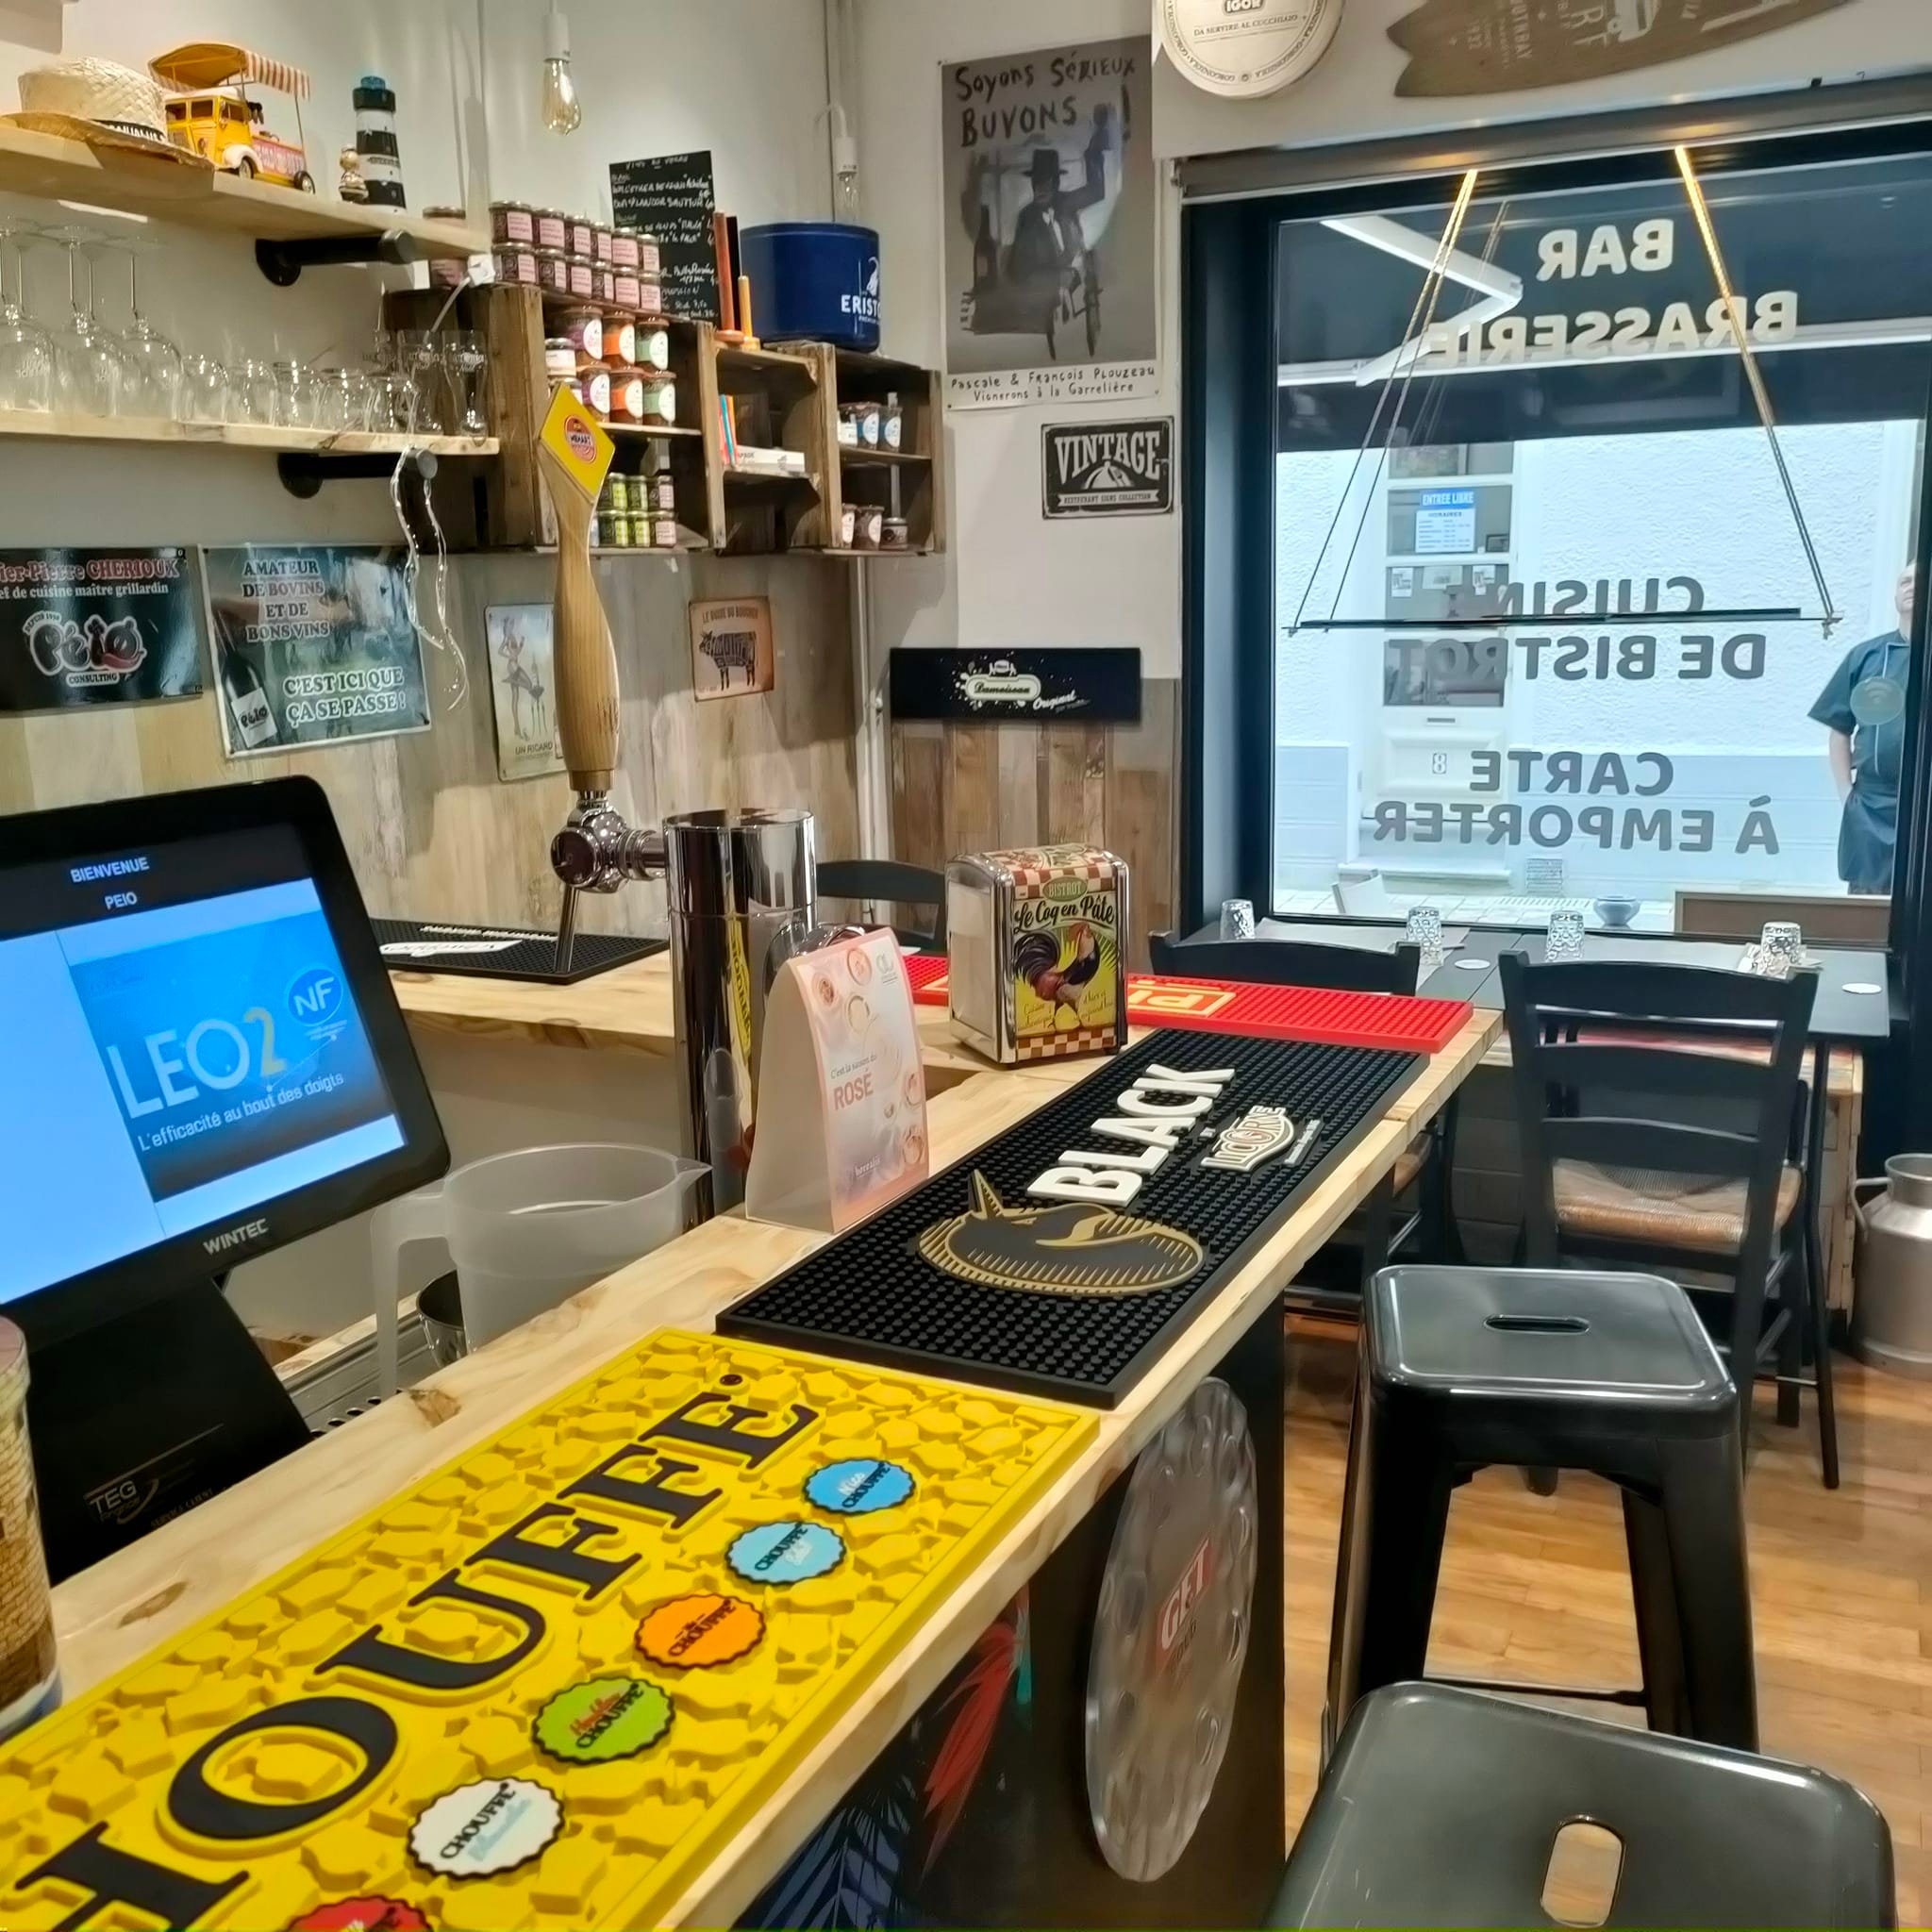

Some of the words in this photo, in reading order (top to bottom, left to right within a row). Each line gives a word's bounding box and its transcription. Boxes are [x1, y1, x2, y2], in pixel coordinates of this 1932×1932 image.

[955, 63, 1036, 103] Soyons
[960, 95, 1078, 148] BUVONS
[974, 390, 1029, 403] Vignerons
[1050, 384, 1060, 397] la
[1010, 373, 1020, 386] &
[1054, 430, 1161, 486] VINTAGE
[86, 558, 180, 580] CHERIOUX
[243, 559, 319, 576] AMATEUR
[12, 588, 27, 599] de
[29, 584, 73, 598] cuisine
[75, 582, 113, 596] maître
[115, 583, 169, 598] grillardin
[242, 582, 265, 598] DE
[268, 580, 325, 596] BOVINS
[266, 604, 286, 619] ET
[288, 603, 309, 617] DE
[246, 625, 290, 642] BONS
[291, 621, 330, 639] VINS
[68, 672, 118, 685] CONSULTING
[339, 671, 365, 691] ICI
[366, 666, 404, 691] QUE
[286, 699, 314, 729] ÇA
[315, 698, 341, 719] SE
[342, 693, 397, 715] PASSE
[515, 743, 526, 755] UN
[527, 741, 554, 754] RICARD
[1432, 754, 1447, 774] 8
[71, 857, 150, 884] BIENVENUE
[105, 891, 139, 910] PEIO
[1049, 881, 1082, 898] BISTROT
[1014, 903, 1035, 934] Le
[1036, 899, 1059, 924] Coq
[1060, 902, 1078, 917] en
[1080, 896, 1115, 924] Pâte
[293, 976, 335, 1017] NF
[106, 1006, 288, 1120] LEO2
[225, 1107, 242, 1123] au
[243, 1092, 275, 1116] bout
[277, 1084, 303, 1106] des
[304, 1073, 344, 1098] doigts
[833, 1067, 874, 1111] ROSÉ
[1026, 1063, 1236, 1207] BLACK
[203, 1218, 270, 1256] WINTEC
[89, 1479, 138, 1516] TEG
[841, 1462, 891, 1509] CHOUFFE
[755, 1523, 809, 1573] CHOUFFE
[668, 1598, 737, 1657] CHOUFFE
[576, 1683, 644, 1749] CHOUFFE
[440, 1782, 517, 1860] CHOUFFE
